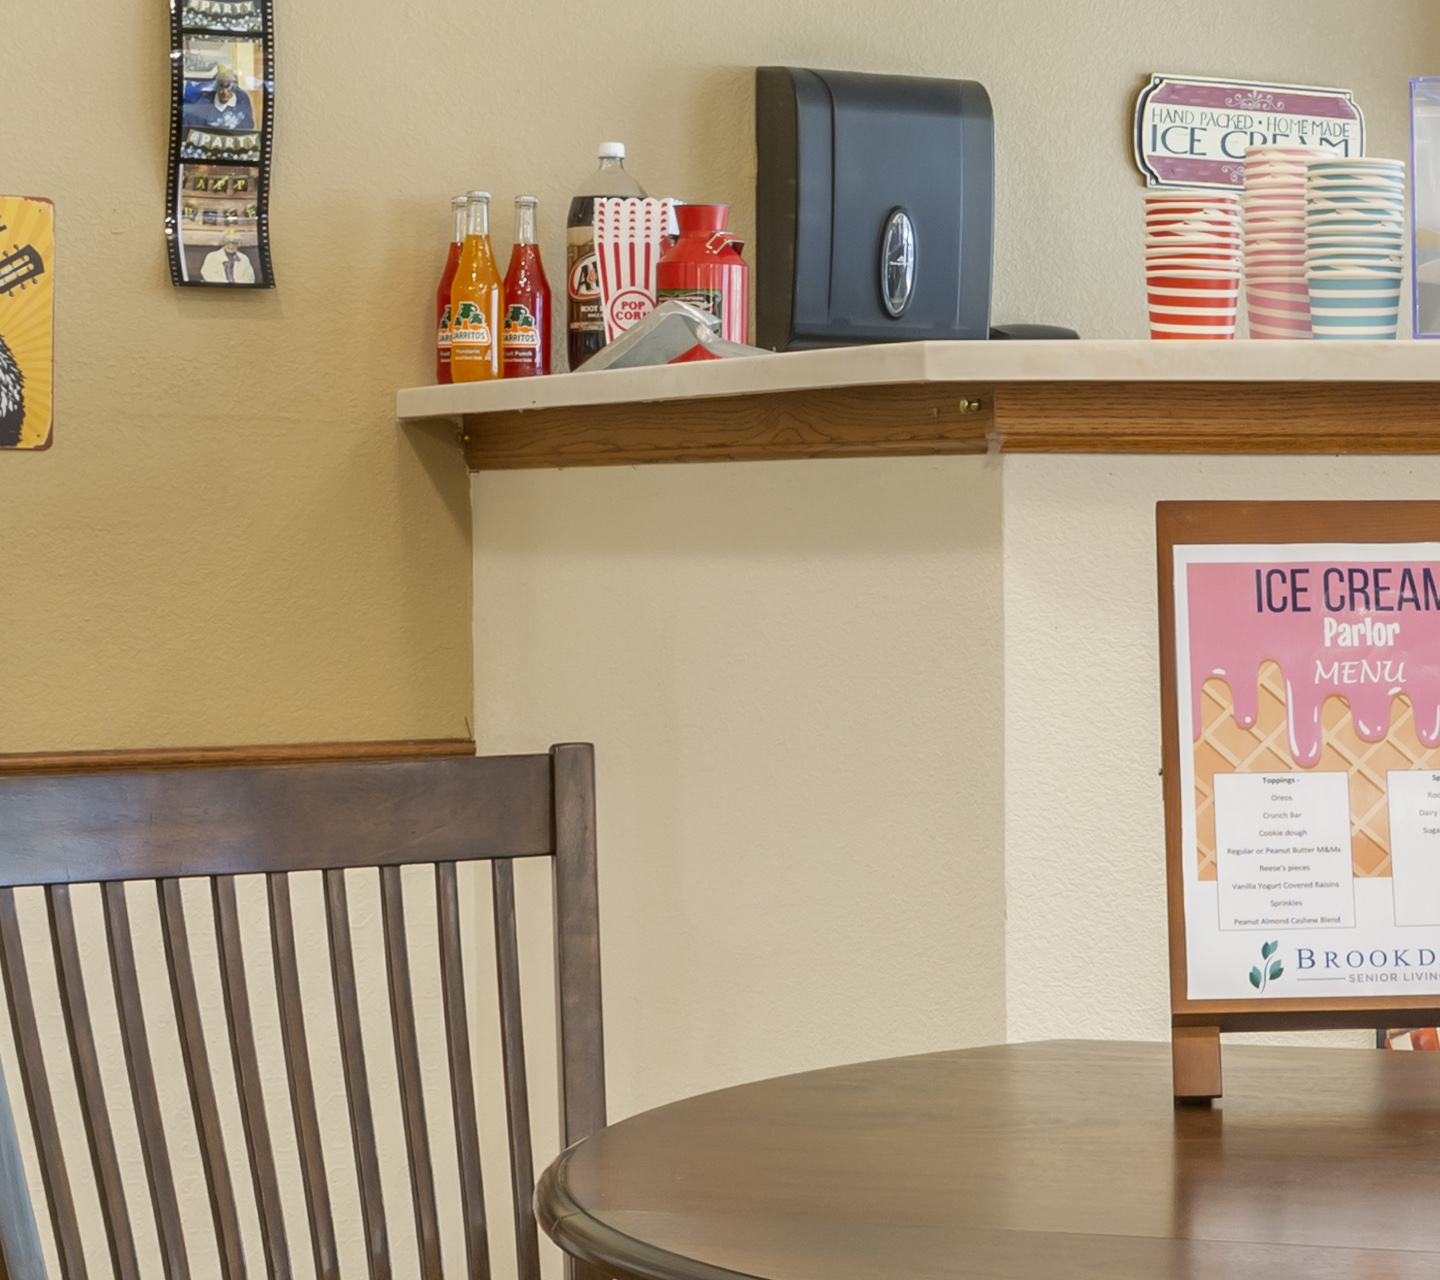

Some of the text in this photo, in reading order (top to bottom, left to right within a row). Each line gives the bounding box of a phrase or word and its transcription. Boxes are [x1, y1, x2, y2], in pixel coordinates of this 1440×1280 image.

[1152, 108, 1195, 125] HAND
[1200, 111, 1254, 130] PACKED
[190, 129, 258, 147] #PARTY
[1151, 124, 1349, 159] ICE CRM
[621, 301, 645, 310] POP
[504, 334, 535, 342] ARRITOS
[1255, 568, 1311, 613] ICE
[1323, 617, 1400, 647] Parlor
[1314, 659, 1407, 685] MENU
[1262, 776, 1295, 785] Toppings
[1271, 793, 1293, 802] Oreos
[1263, 811, 1302, 819] Crunch Bar
[1419, 808, 1438, 817] Dairy
[1259, 828, 1307, 838] Cookie dough
[1227, 847, 1254, 856] Regular
[1265, 846, 1291, 854] Peanut
[1292, 845, 1315, 853] Butter
[1317, 845, 1341, 853] M&Ms
[1259, 864, 1310, 873] Reese's pieces
[1232, 880, 1339, 891] Vanilla Yogurt Covered Raisins
[1270, 899, 1303, 907] Sprinkles
[1234, 915, 1341, 925] Peanut Almond Cashew Blend
[1349, 973, 1398, 983] SENIOR
